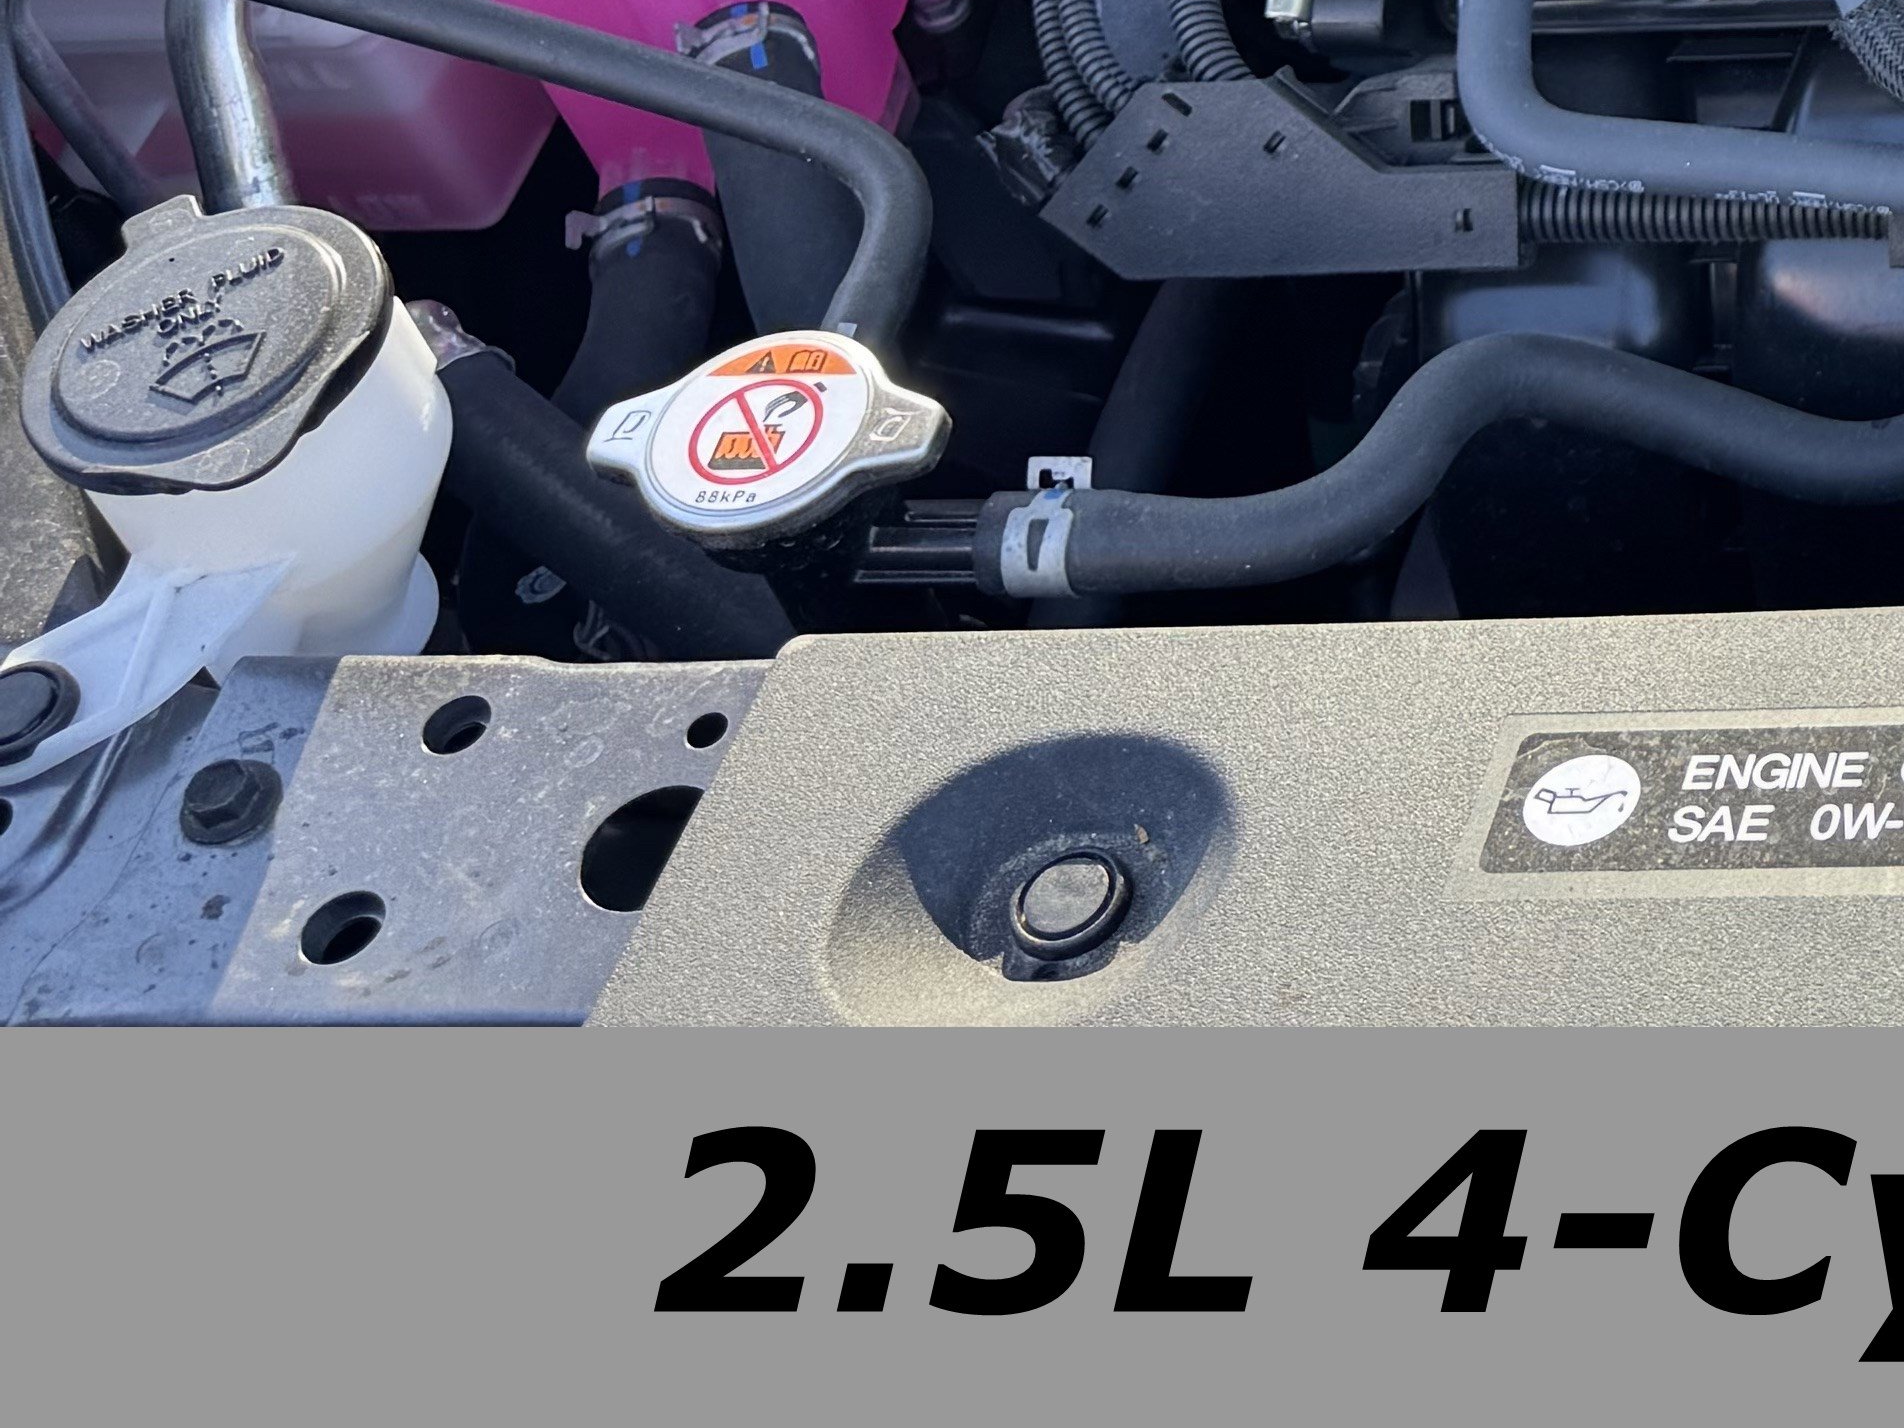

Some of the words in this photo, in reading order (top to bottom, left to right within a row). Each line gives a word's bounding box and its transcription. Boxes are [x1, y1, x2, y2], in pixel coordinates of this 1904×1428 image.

[80, 288, 201, 353] WASHER
[209, 247, 285, 294] FLUID
[156, 294, 222, 338] ONLY
[694, 490, 758, 504] 88kPa
[1681, 751, 1870, 790] ENGINE
[1667, 804, 1776, 843] SAE
